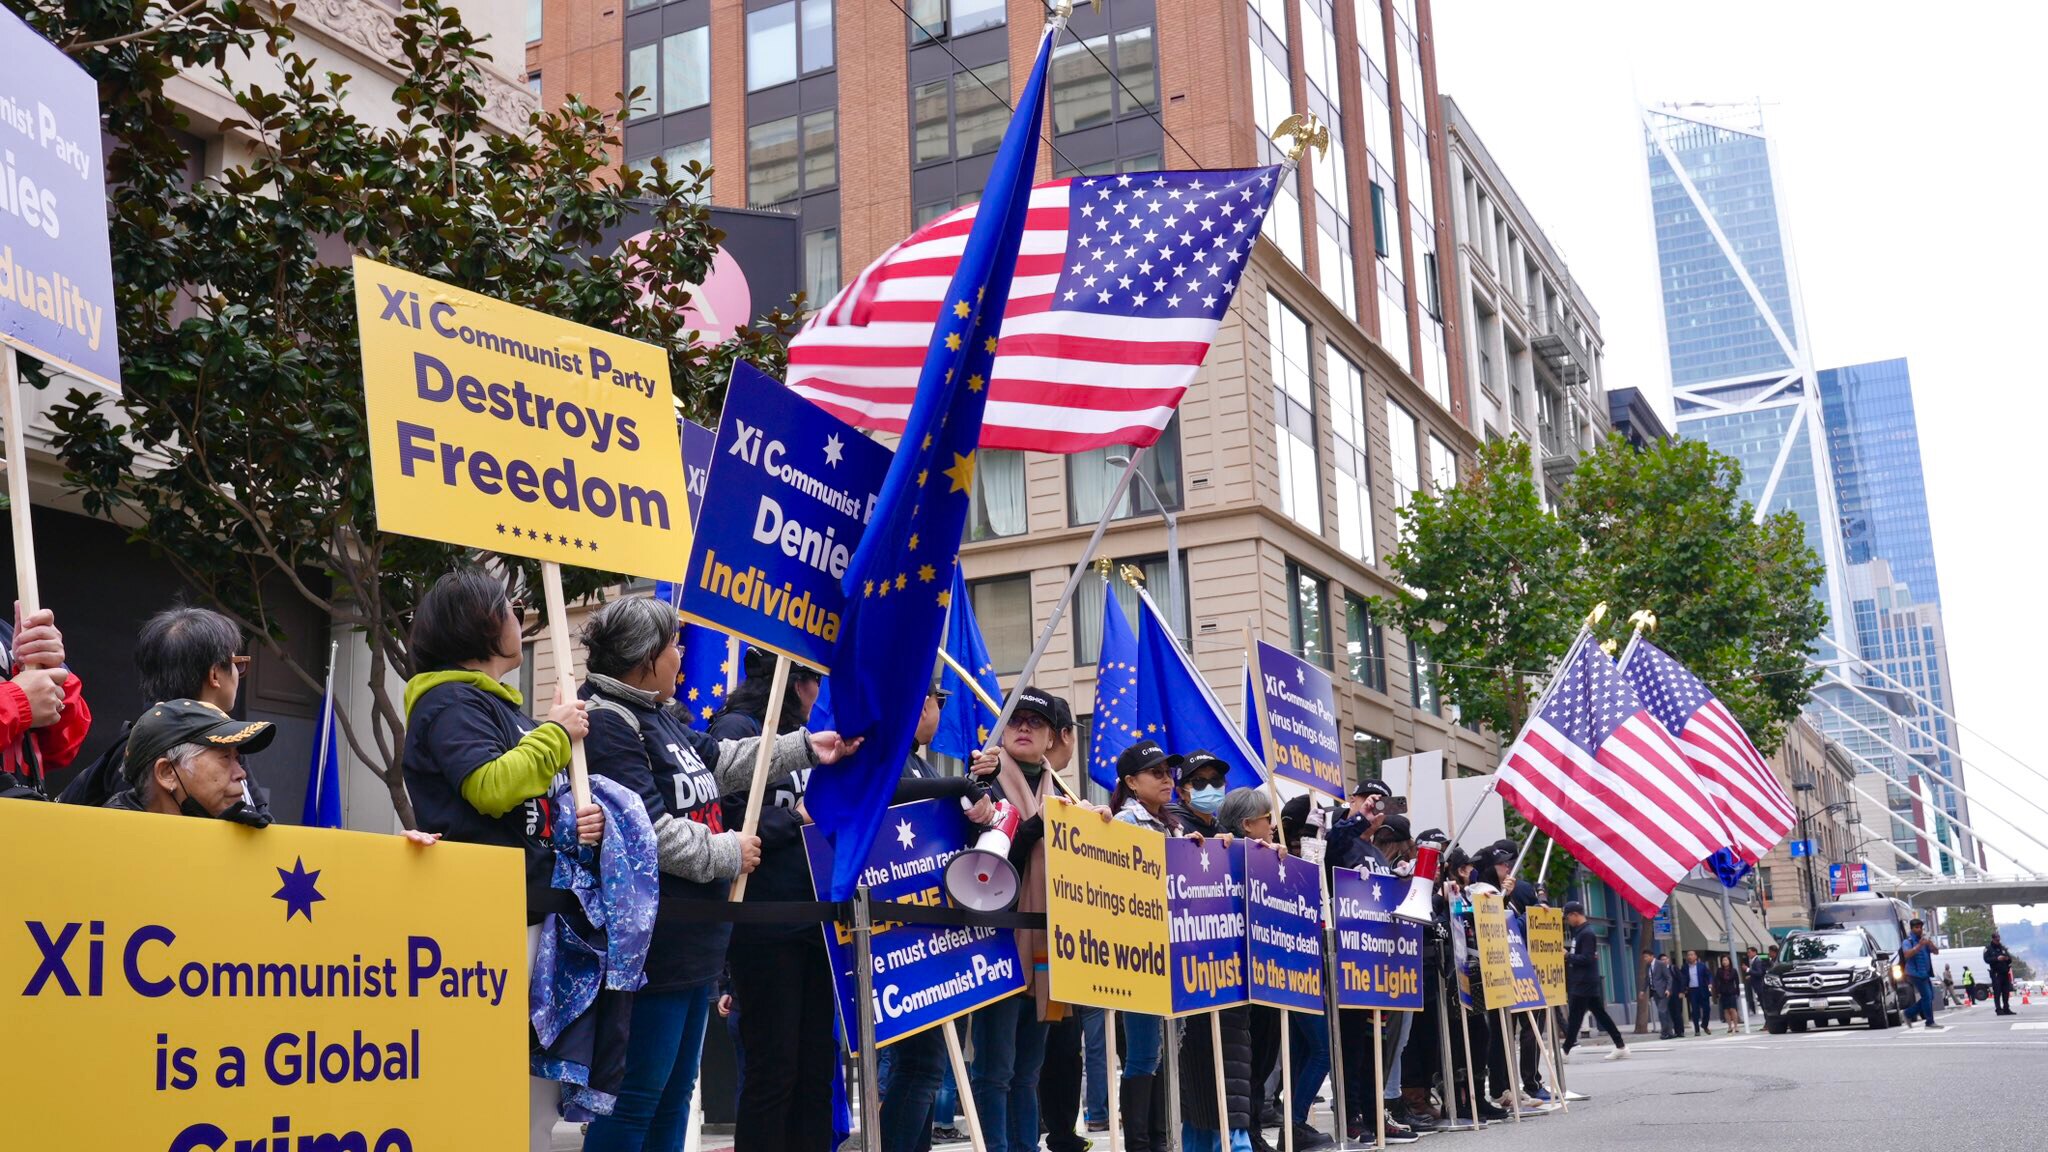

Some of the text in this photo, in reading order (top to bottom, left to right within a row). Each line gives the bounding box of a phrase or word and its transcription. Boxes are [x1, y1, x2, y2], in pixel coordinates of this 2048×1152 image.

[38, 101, 90, 181] Party
[0, 149, 60, 239] ies
[377, 283, 656, 399] Xi Communist Party
[413, 351, 641, 453] Destroys
[396, 419, 671, 531] Freedom
[686, 464, 706, 498] Xi
[728, 418, 764, 467] Xi
[763, 440, 862, 521] Communist
[752, 494, 858, 581] Denie
[1264, 673, 1334, 726] Xi Communist Party
[1268, 709, 1339, 754] virus brings death
[1272, 738, 1342, 788] to the world
[524, 799, 537, 836] The
[865, 862, 888, 887] the
[890, 856, 936, 881] human
[1051, 820, 1161, 880] Xi Communist Party
[1053, 874, 1164, 922] virus brings death
[1177, 874, 1225, 900] Communist
[1224, 873, 1245, 899] Party
[1250, 878, 1318, 923] Xi Communist Party
[1339, 896, 1350, 918] Xi
[887, 935, 928, 971] must
[928, 925, 974, 955] defeat
[1168, 908, 1245, 943] Inhumane
[1251, 920, 1319, 956] virus brings death
[1340, 930, 1418, 957] Will Stomp Out
[1530, 939, 1562, 955] Will Stomp Out
[21, 920, 509, 1007] Xi Communist Party
[1054, 924, 1166, 977] to the world
[883, 970, 976, 1019] Communist
[972, 953, 1013, 986] Party
[1181, 951, 1242, 998] Unjust
[1252, 955, 1321, 996] to the world
[1341, 961, 1418, 999] The Light
[1546, 963, 1564, 989] Light
[155, 1028, 421, 1092] is a Global
